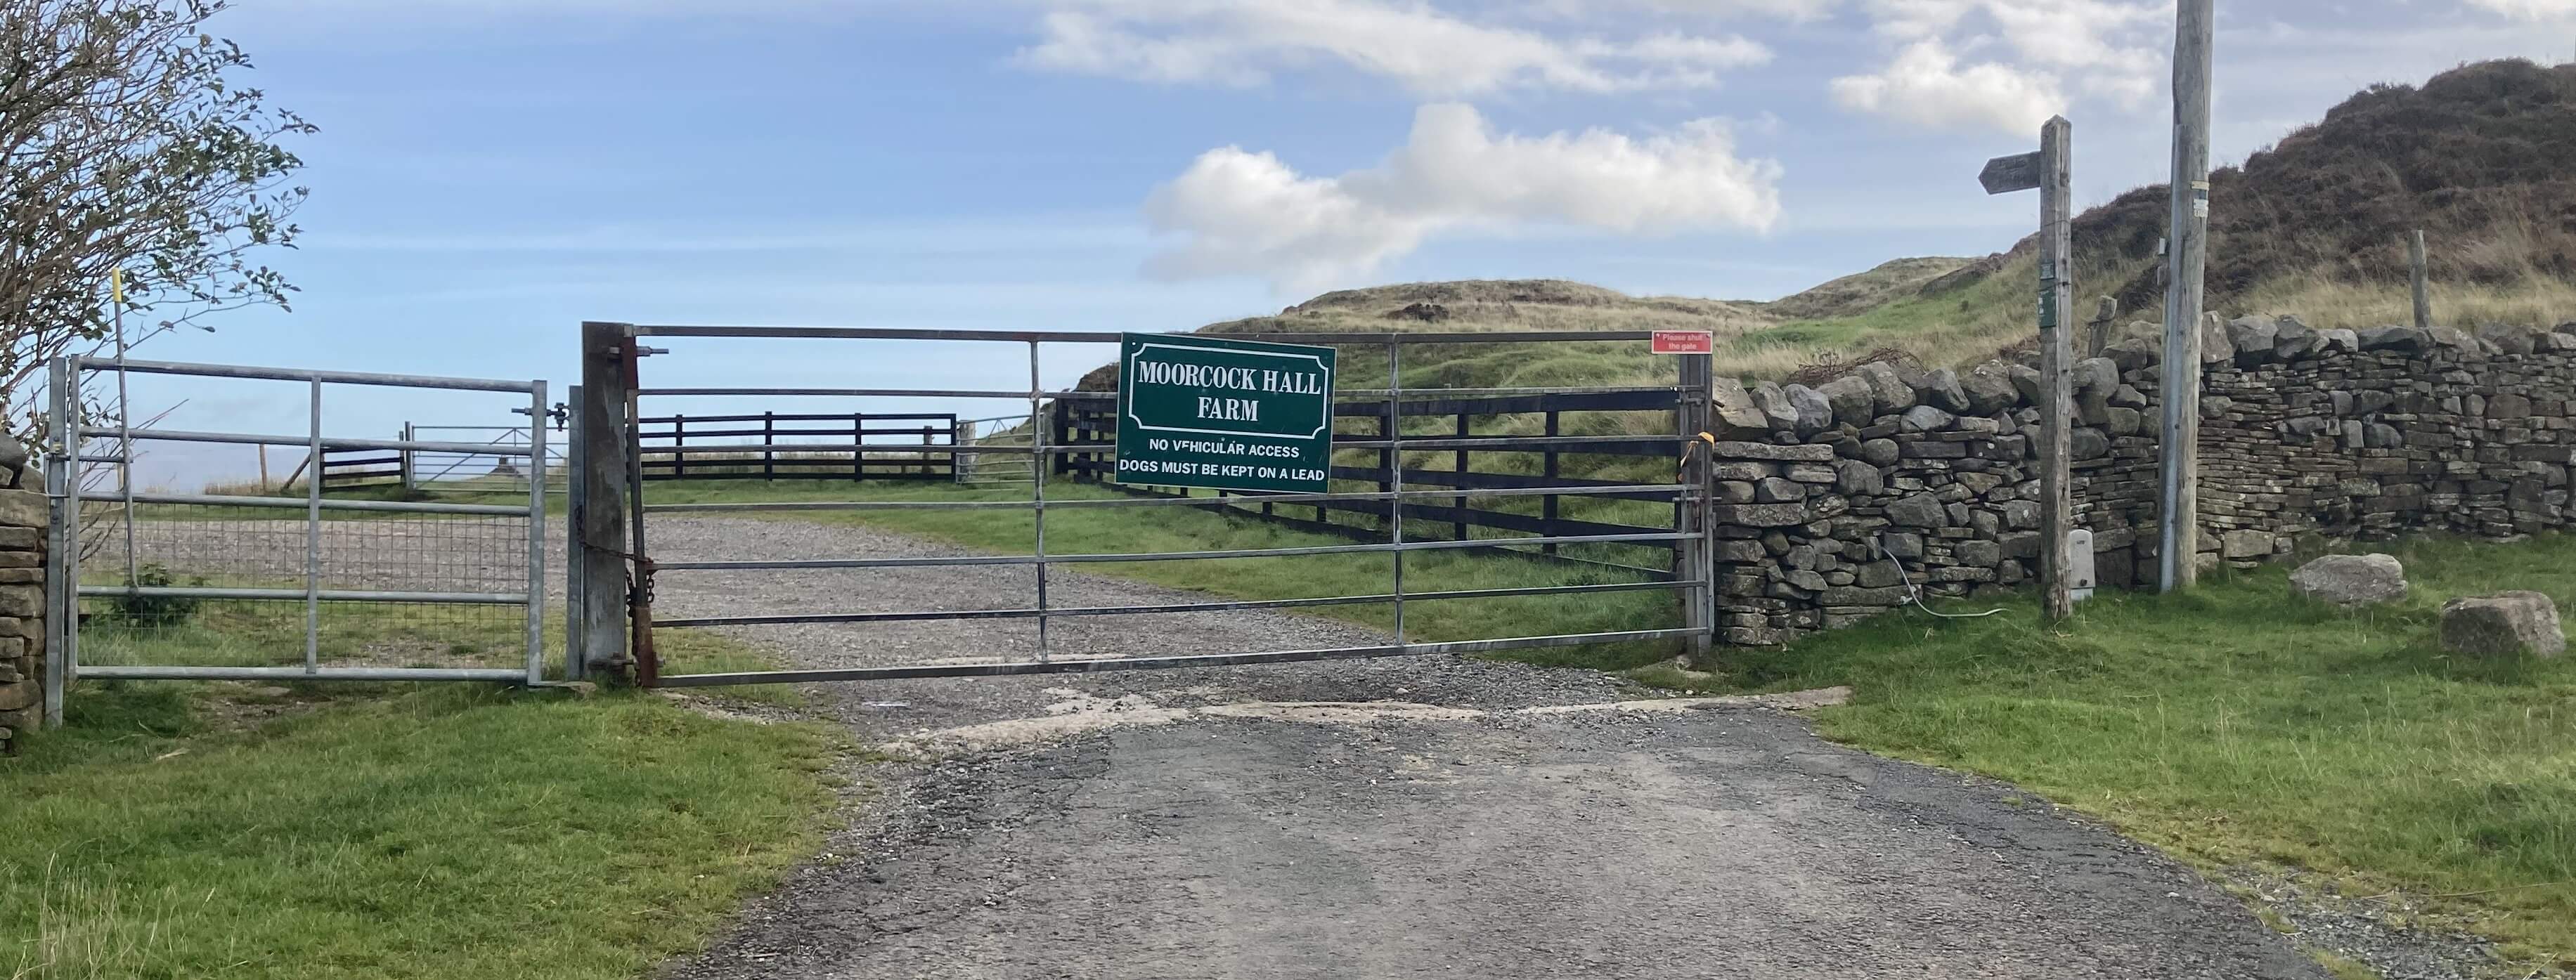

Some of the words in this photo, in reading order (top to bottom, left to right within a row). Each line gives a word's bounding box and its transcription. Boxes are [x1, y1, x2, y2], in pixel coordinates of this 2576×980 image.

[1138, 360, 1257, 391] MOORCOCK
[1262, 370, 1321, 395] HALL
[1197, 396, 1259, 422] FARM
[1149, 438, 1169, 451] NO
[1248, 444, 1300, 458] ACCESS
[1120, 459, 1158, 473] DOGS
[1161, 462, 1198, 475] MUST
[1201, 464, 1219, 476] BE
[1222, 464, 1255, 477] KEPT
[1257, 466, 1276, 479] ON
[1279, 468, 1288, 479] A
[1291, 469, 1325, 481] LEAD
